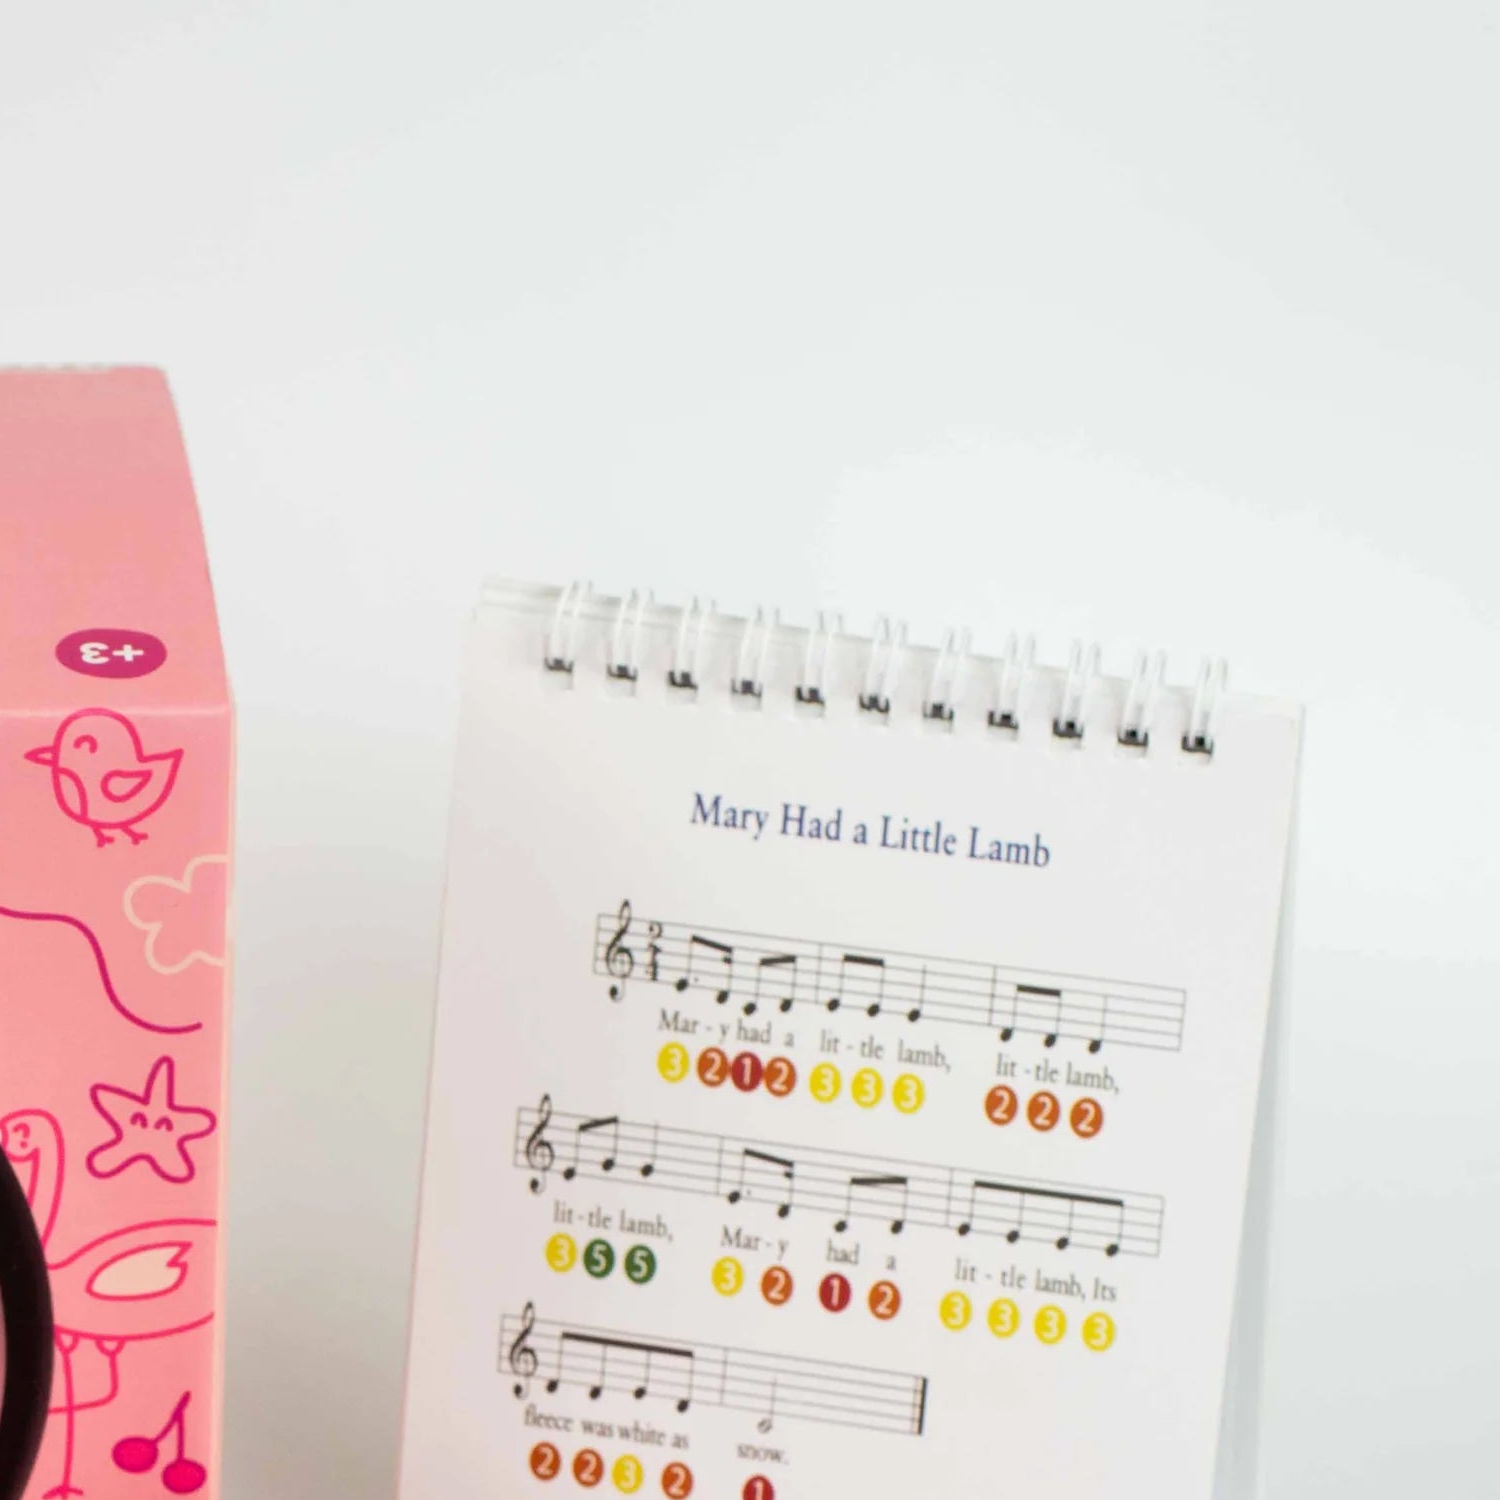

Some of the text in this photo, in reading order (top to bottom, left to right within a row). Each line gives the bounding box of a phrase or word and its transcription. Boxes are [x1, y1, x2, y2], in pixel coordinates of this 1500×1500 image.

[78, 640, 146, 667] +3
[690, 792, 1051, 868] Mary Had a Little Lamb
[736, 1018, 773, 1045] had
[783, 1032, 795, 1048] a
[896, 1039, 952, 1073] lamb,
[1065, 1061, 1120, 1096] lamb,
[619, 1209, 674, 1242] lamb,
[826, 1239, 861, 1265] had
[885, 1255, 897, 1271] a
[1034, 1268, 1087, 1302] lamb,
[1092, 1277, 1118, 1302] Its
[523, 1403, 790, 1465] fleece was white as snow.
